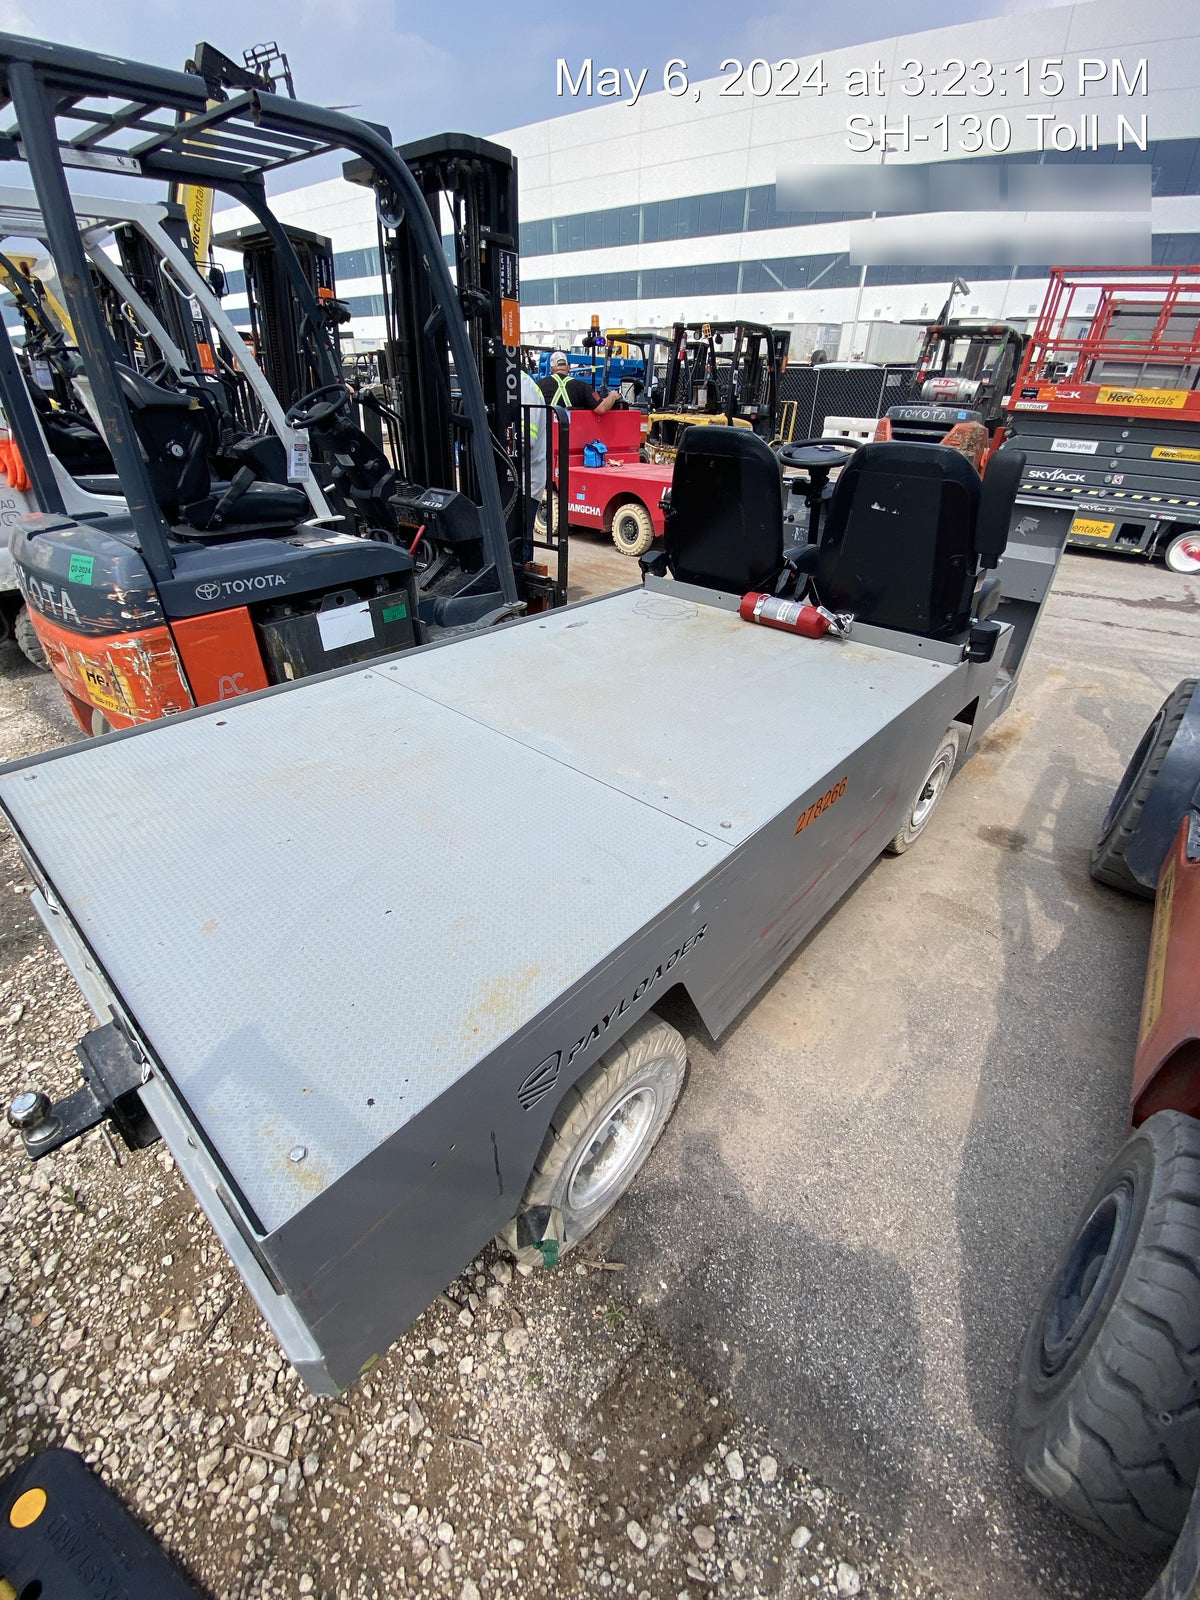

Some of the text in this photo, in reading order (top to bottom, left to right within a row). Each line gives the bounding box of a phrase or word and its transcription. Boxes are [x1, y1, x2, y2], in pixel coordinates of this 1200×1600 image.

[1107, 392, 1175, 406] HercRentals
[899, 409, 947, 420] TOYOTA
[1028, 467, 1086, 482] SKYJACK
[221, 574, 286, 595] TOYOTA
[793, 776, 848, 837] 278266
[567, 922, 708, 1067] PAYLOADER
